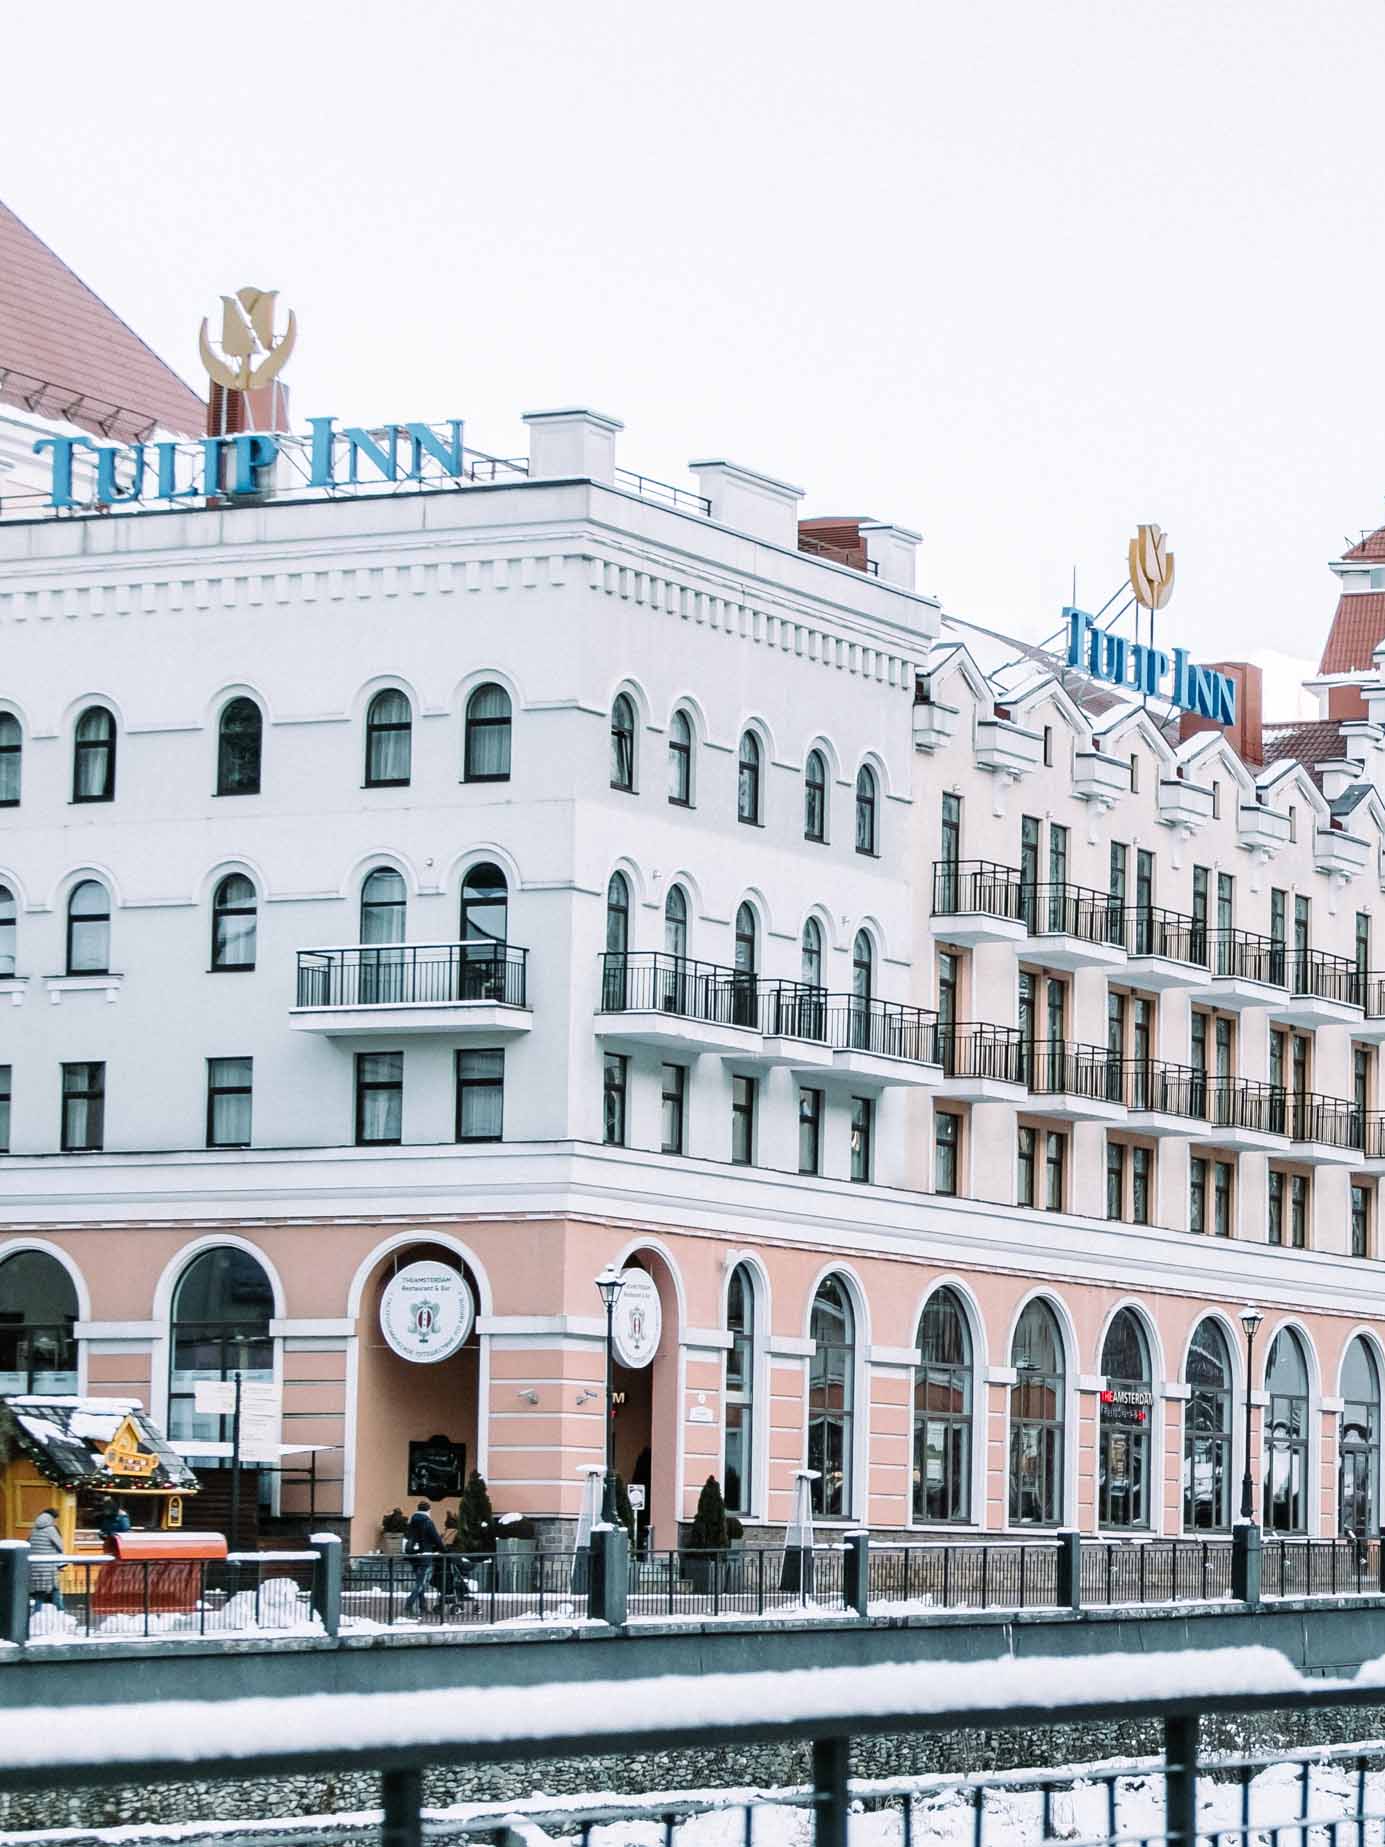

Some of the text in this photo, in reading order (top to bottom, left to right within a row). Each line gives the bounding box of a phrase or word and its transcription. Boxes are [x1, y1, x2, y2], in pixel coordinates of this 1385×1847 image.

[33, 416, 465, 510] TULIP INN
[1062, 606, 1236, 727] TULIP INN
